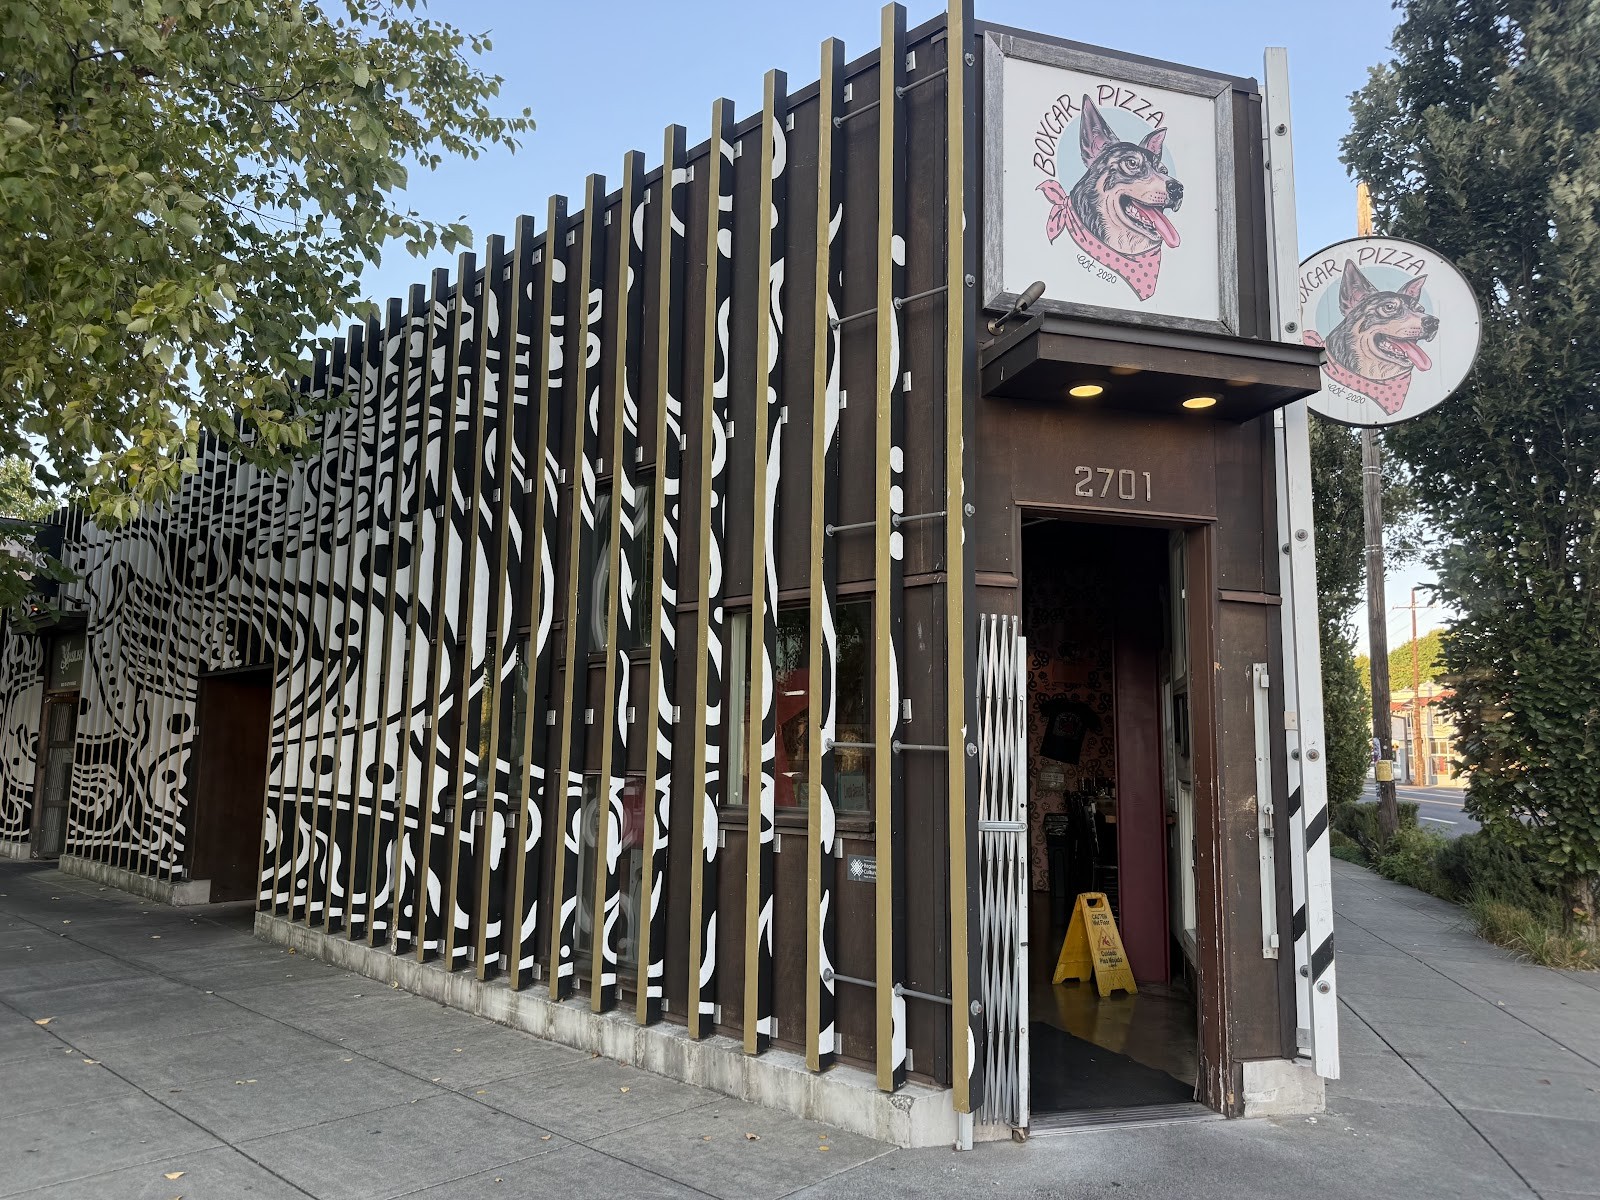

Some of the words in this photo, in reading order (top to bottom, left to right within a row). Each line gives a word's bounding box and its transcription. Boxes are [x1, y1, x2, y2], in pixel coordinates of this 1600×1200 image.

[1033, 94, 1080, 177] BOXCAR
[1097, 85, 1166, 128] PIZZA
[1077, 253, 1096, 273] est
[1096, 268, 1117, 285] 2020
[1357, 247, 1428, 276] PIZZA
[1328, 383, 1346, 398] est
[1346, 392, 1366, 405] 2020
[1074, 465, 1151, 502] 2701
